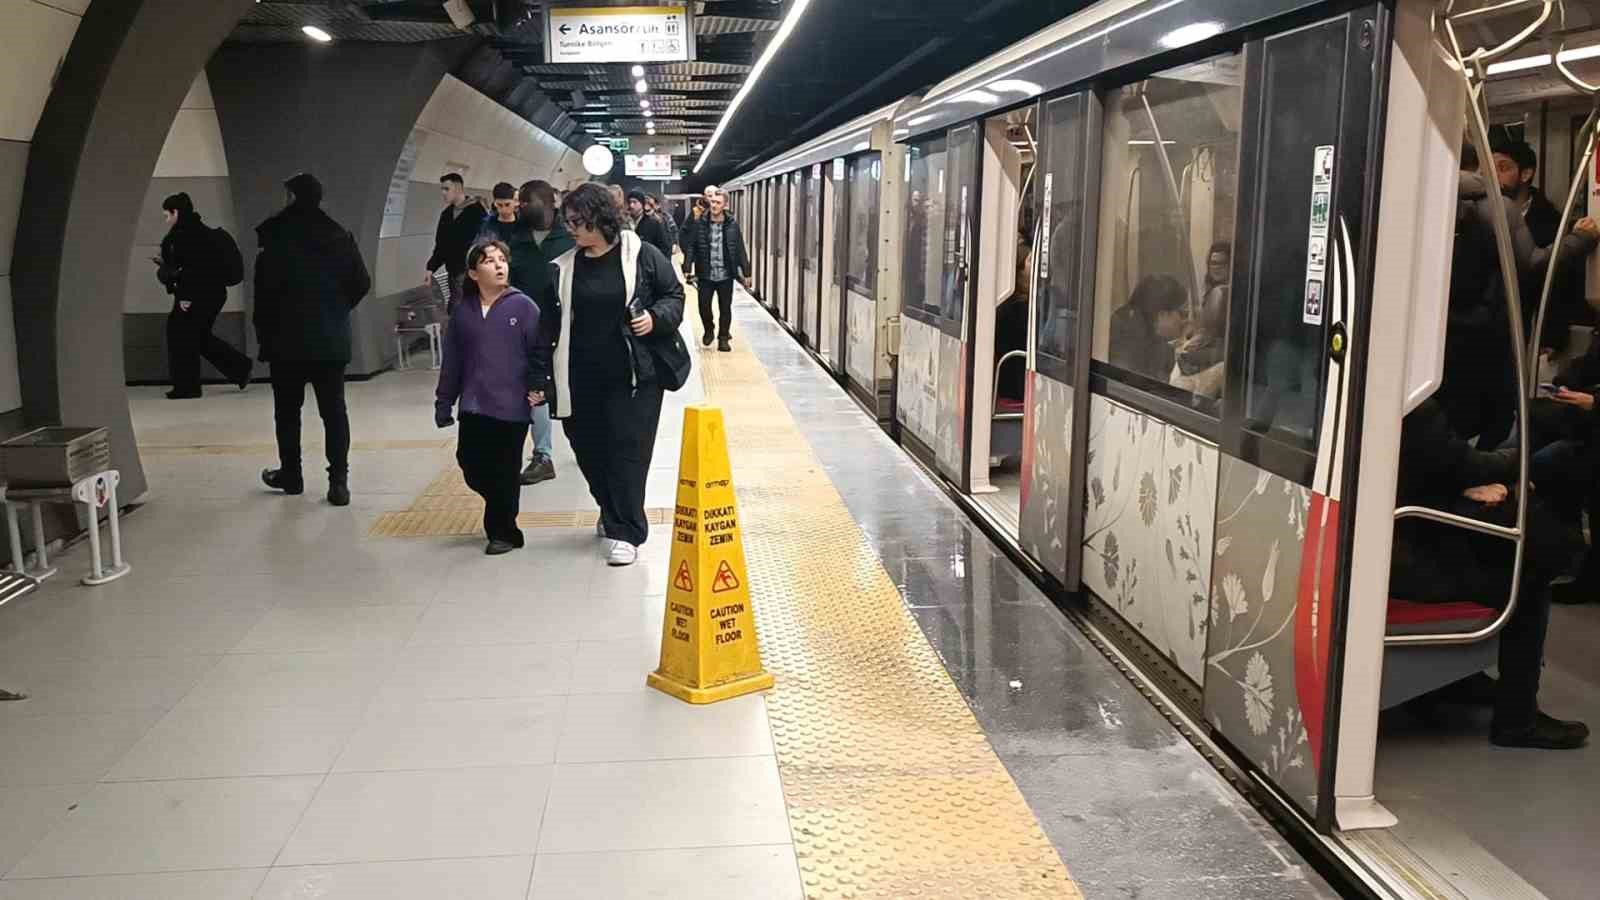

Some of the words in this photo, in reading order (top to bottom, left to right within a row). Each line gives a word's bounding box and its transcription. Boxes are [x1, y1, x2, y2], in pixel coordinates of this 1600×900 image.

[704, 519, 736, 532] KAYGAN
[710, 602, 744, 619] CAUTION
[720, 618, 736, 630] WET
[715, 630, 742, 645] FLOOR
